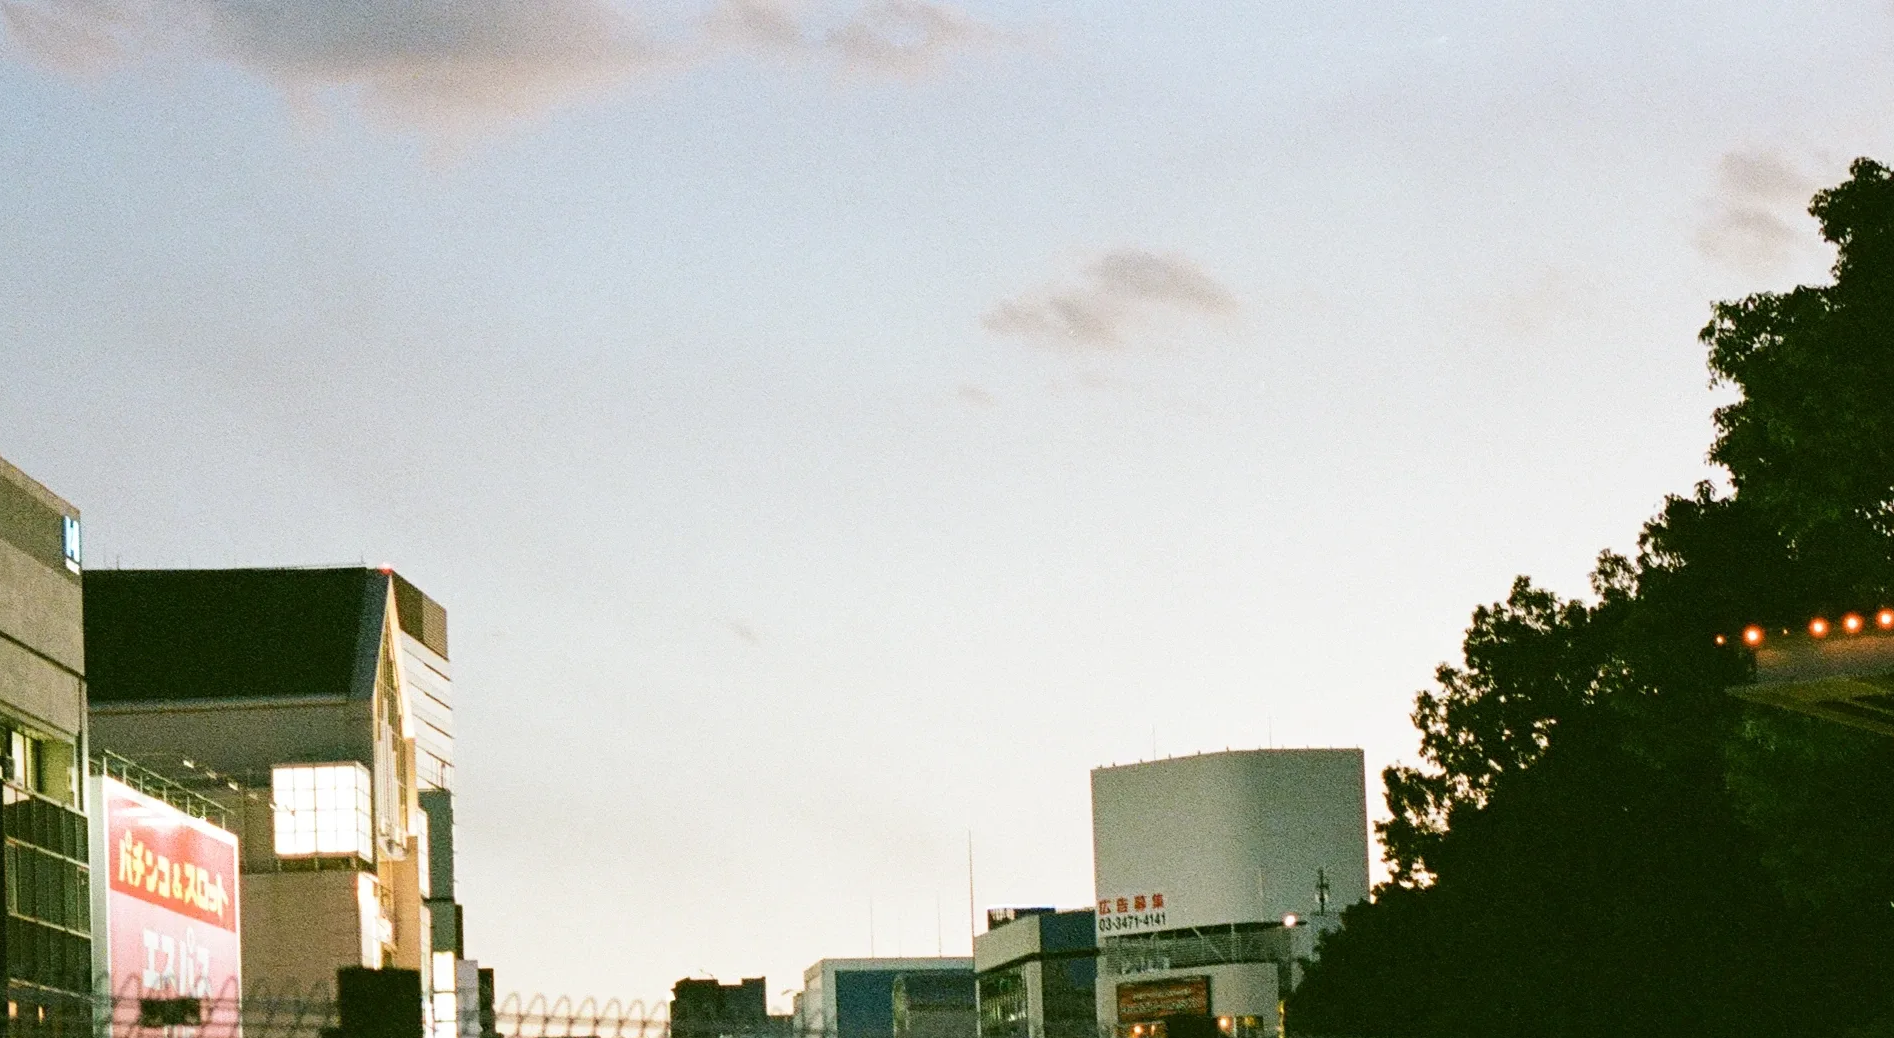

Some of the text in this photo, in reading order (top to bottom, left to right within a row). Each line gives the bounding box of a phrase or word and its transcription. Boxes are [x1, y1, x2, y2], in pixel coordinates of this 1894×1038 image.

[1098, 893, 1164, 916] 広告募集
[1099, 912, 1166, 932] 03-3471-4141
